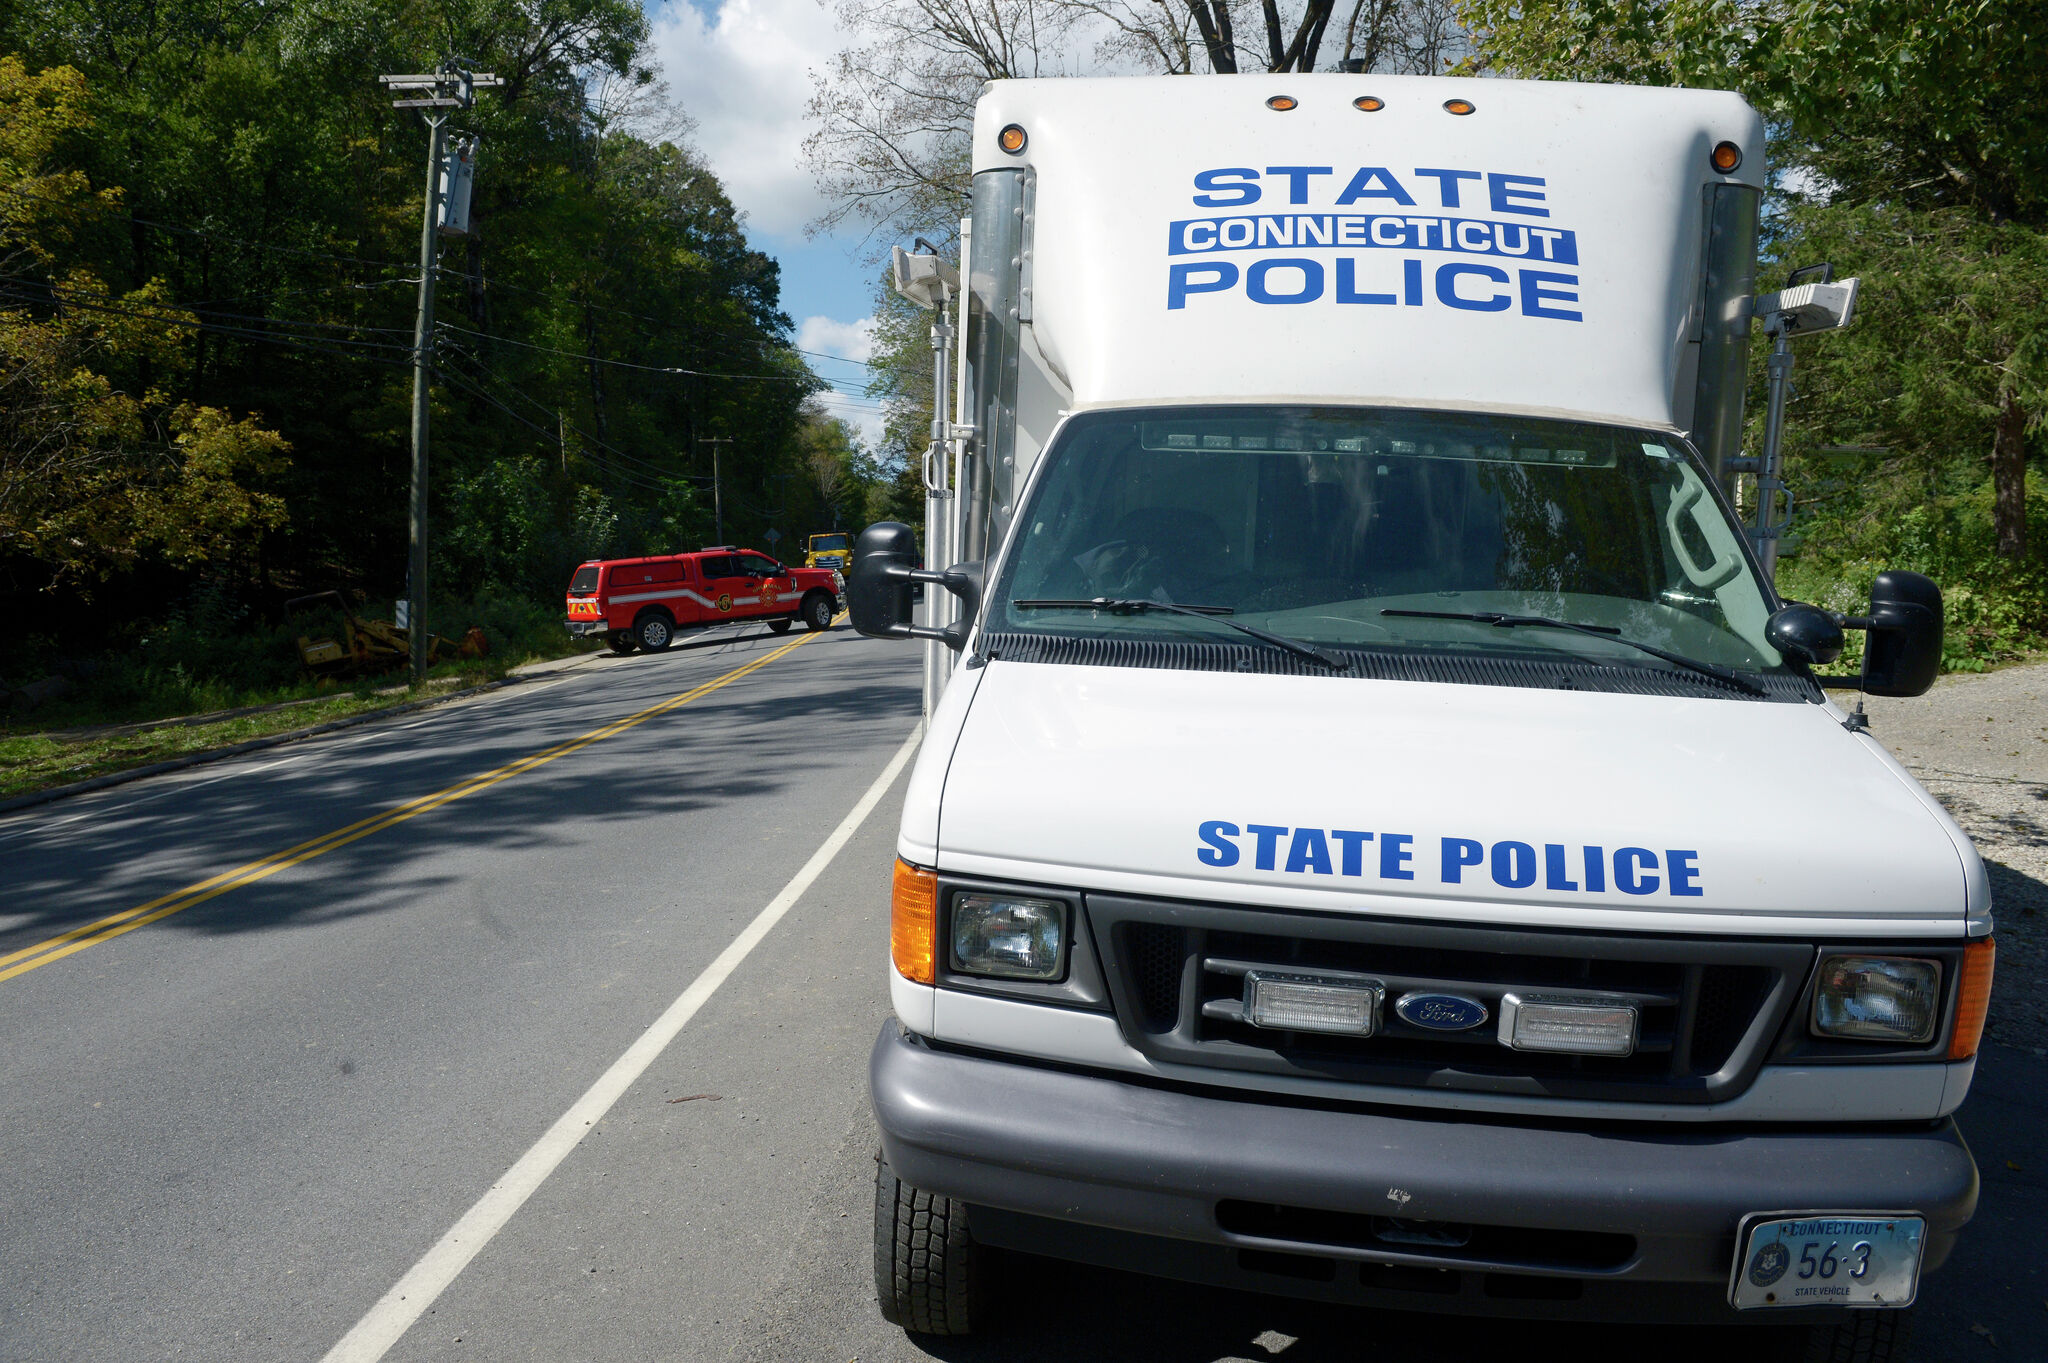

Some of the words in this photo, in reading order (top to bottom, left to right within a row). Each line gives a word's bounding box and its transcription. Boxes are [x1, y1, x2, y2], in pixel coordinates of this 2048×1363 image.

[1192, 166, 1550, 218] STATE
[1183, 216, 1562, 259] CONNECTICUT
[1167, 257, 1584, 322] POLICE
[1196, 820, 1415, 881] STATE
[1440, 837, 1704, 897] POLICE
[1419, 1001, 1466, 1023] Ford
[1792, 1222, 1882, 1236] CONNECTICUT
[1795, 1287, 1818, 1296] STATE
[1819, 1287, 1850, 1296] VEHICLE
